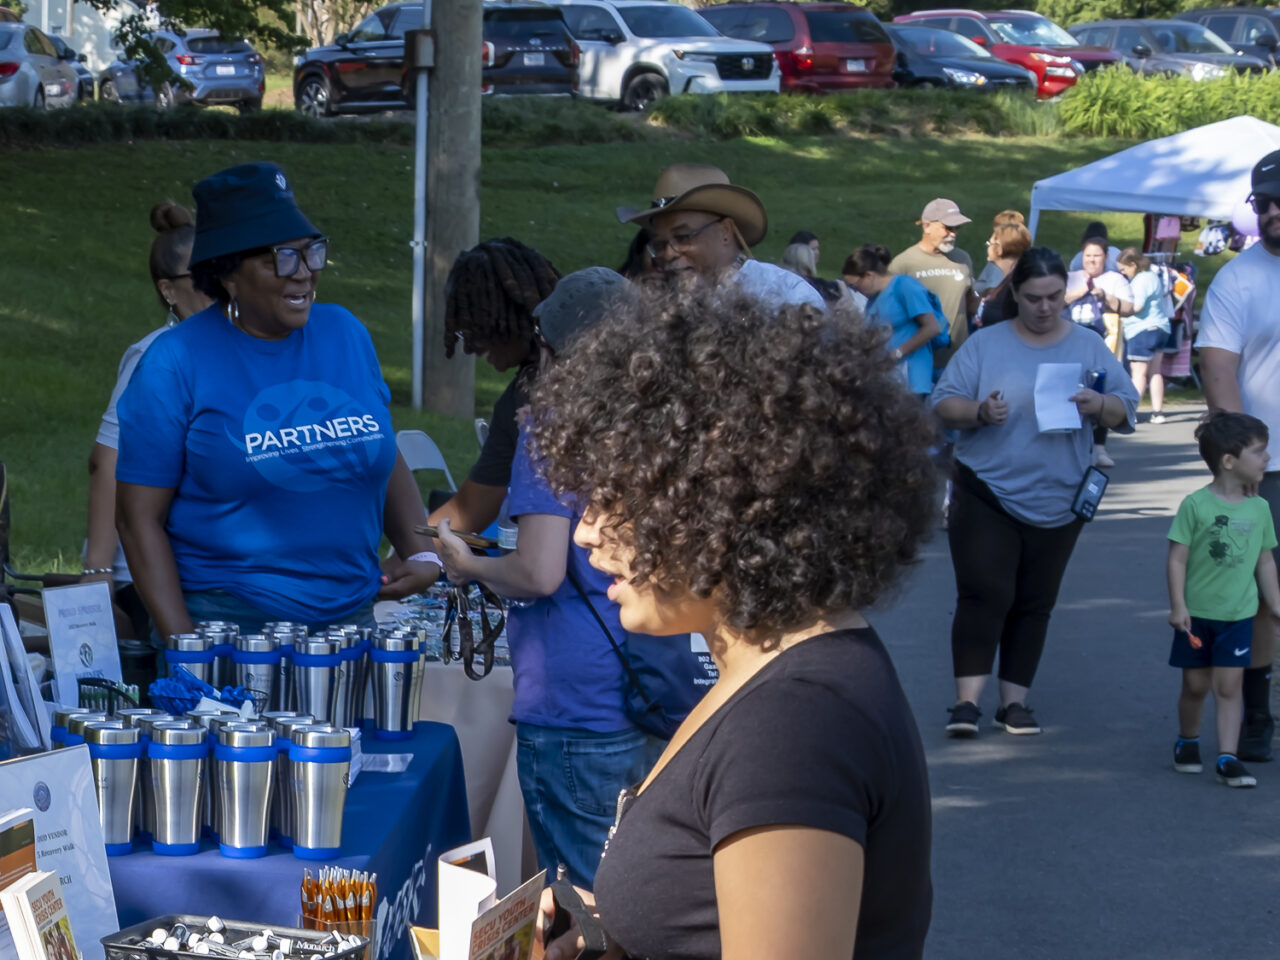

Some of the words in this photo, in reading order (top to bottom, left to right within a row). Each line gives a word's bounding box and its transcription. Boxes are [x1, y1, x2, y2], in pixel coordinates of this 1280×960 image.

[245, 414, 380, 454] PARTNERS
[31, 897, 43, 914] SECU
[42, 889, 55, 906] YOUTH
[35, 907, 49, 926] CRISIS
[48, 897, 63, 917] CENTER
[472, 926, 500, 956] CRISIS
[501, 901, 536, 934] CENTER
[473, 917, 497, 943] SECU
[498, 896, 527, 926] YOUTH
[295, 940, 336, 953] Monarch
